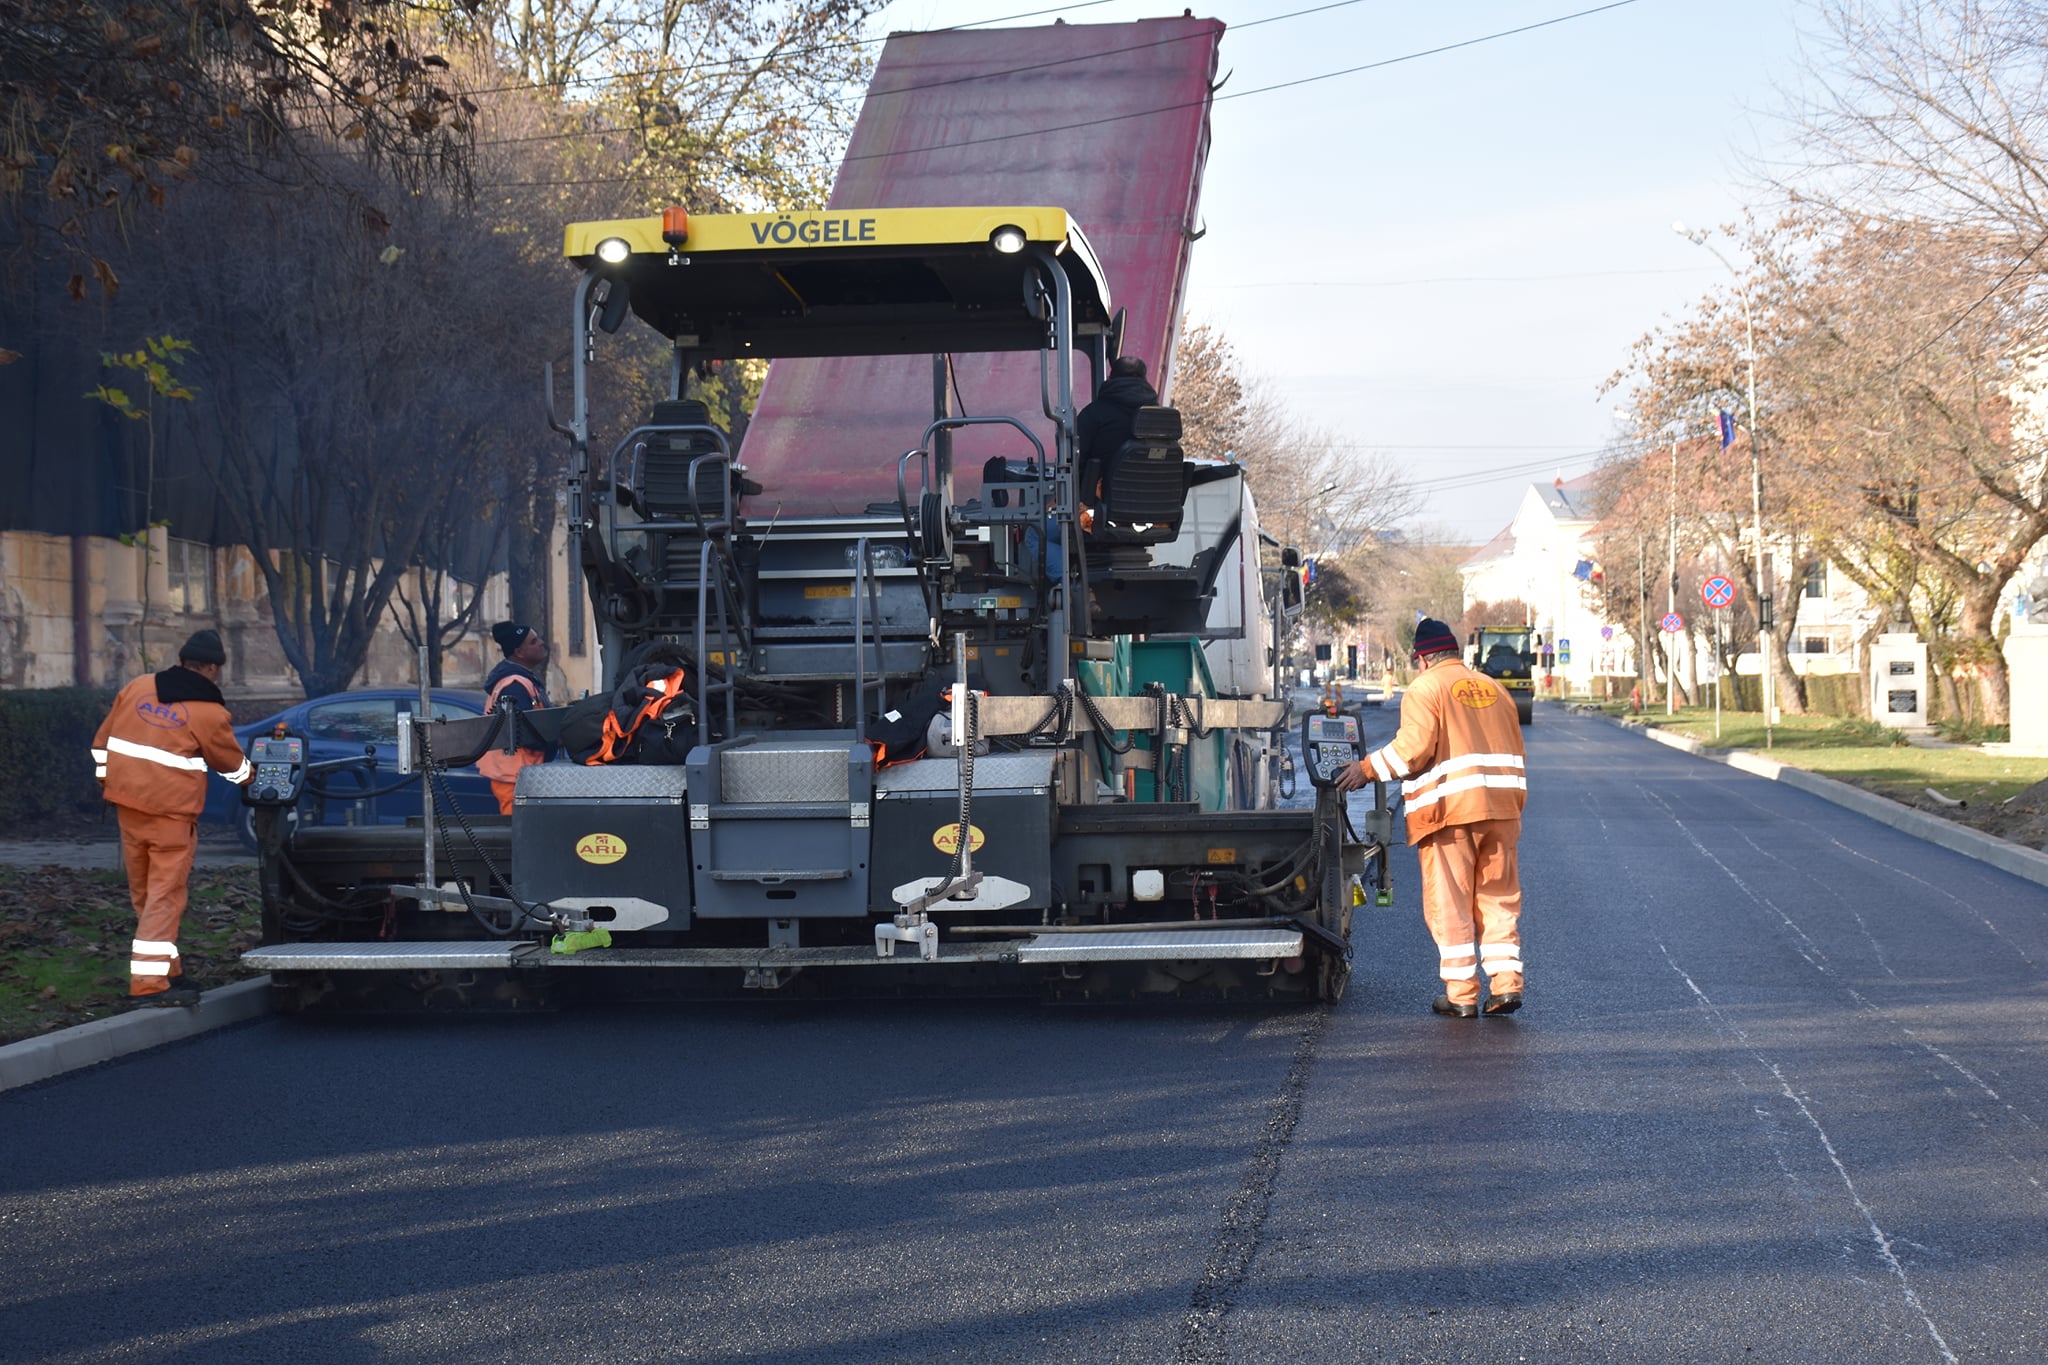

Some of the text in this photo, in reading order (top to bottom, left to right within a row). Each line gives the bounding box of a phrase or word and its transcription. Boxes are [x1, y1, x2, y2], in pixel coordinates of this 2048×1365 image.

[751, 215, 876, 245] VÖGELE
[1457, 689, 1497, 698] ARL
[580, 845, 625, 854] ARL
